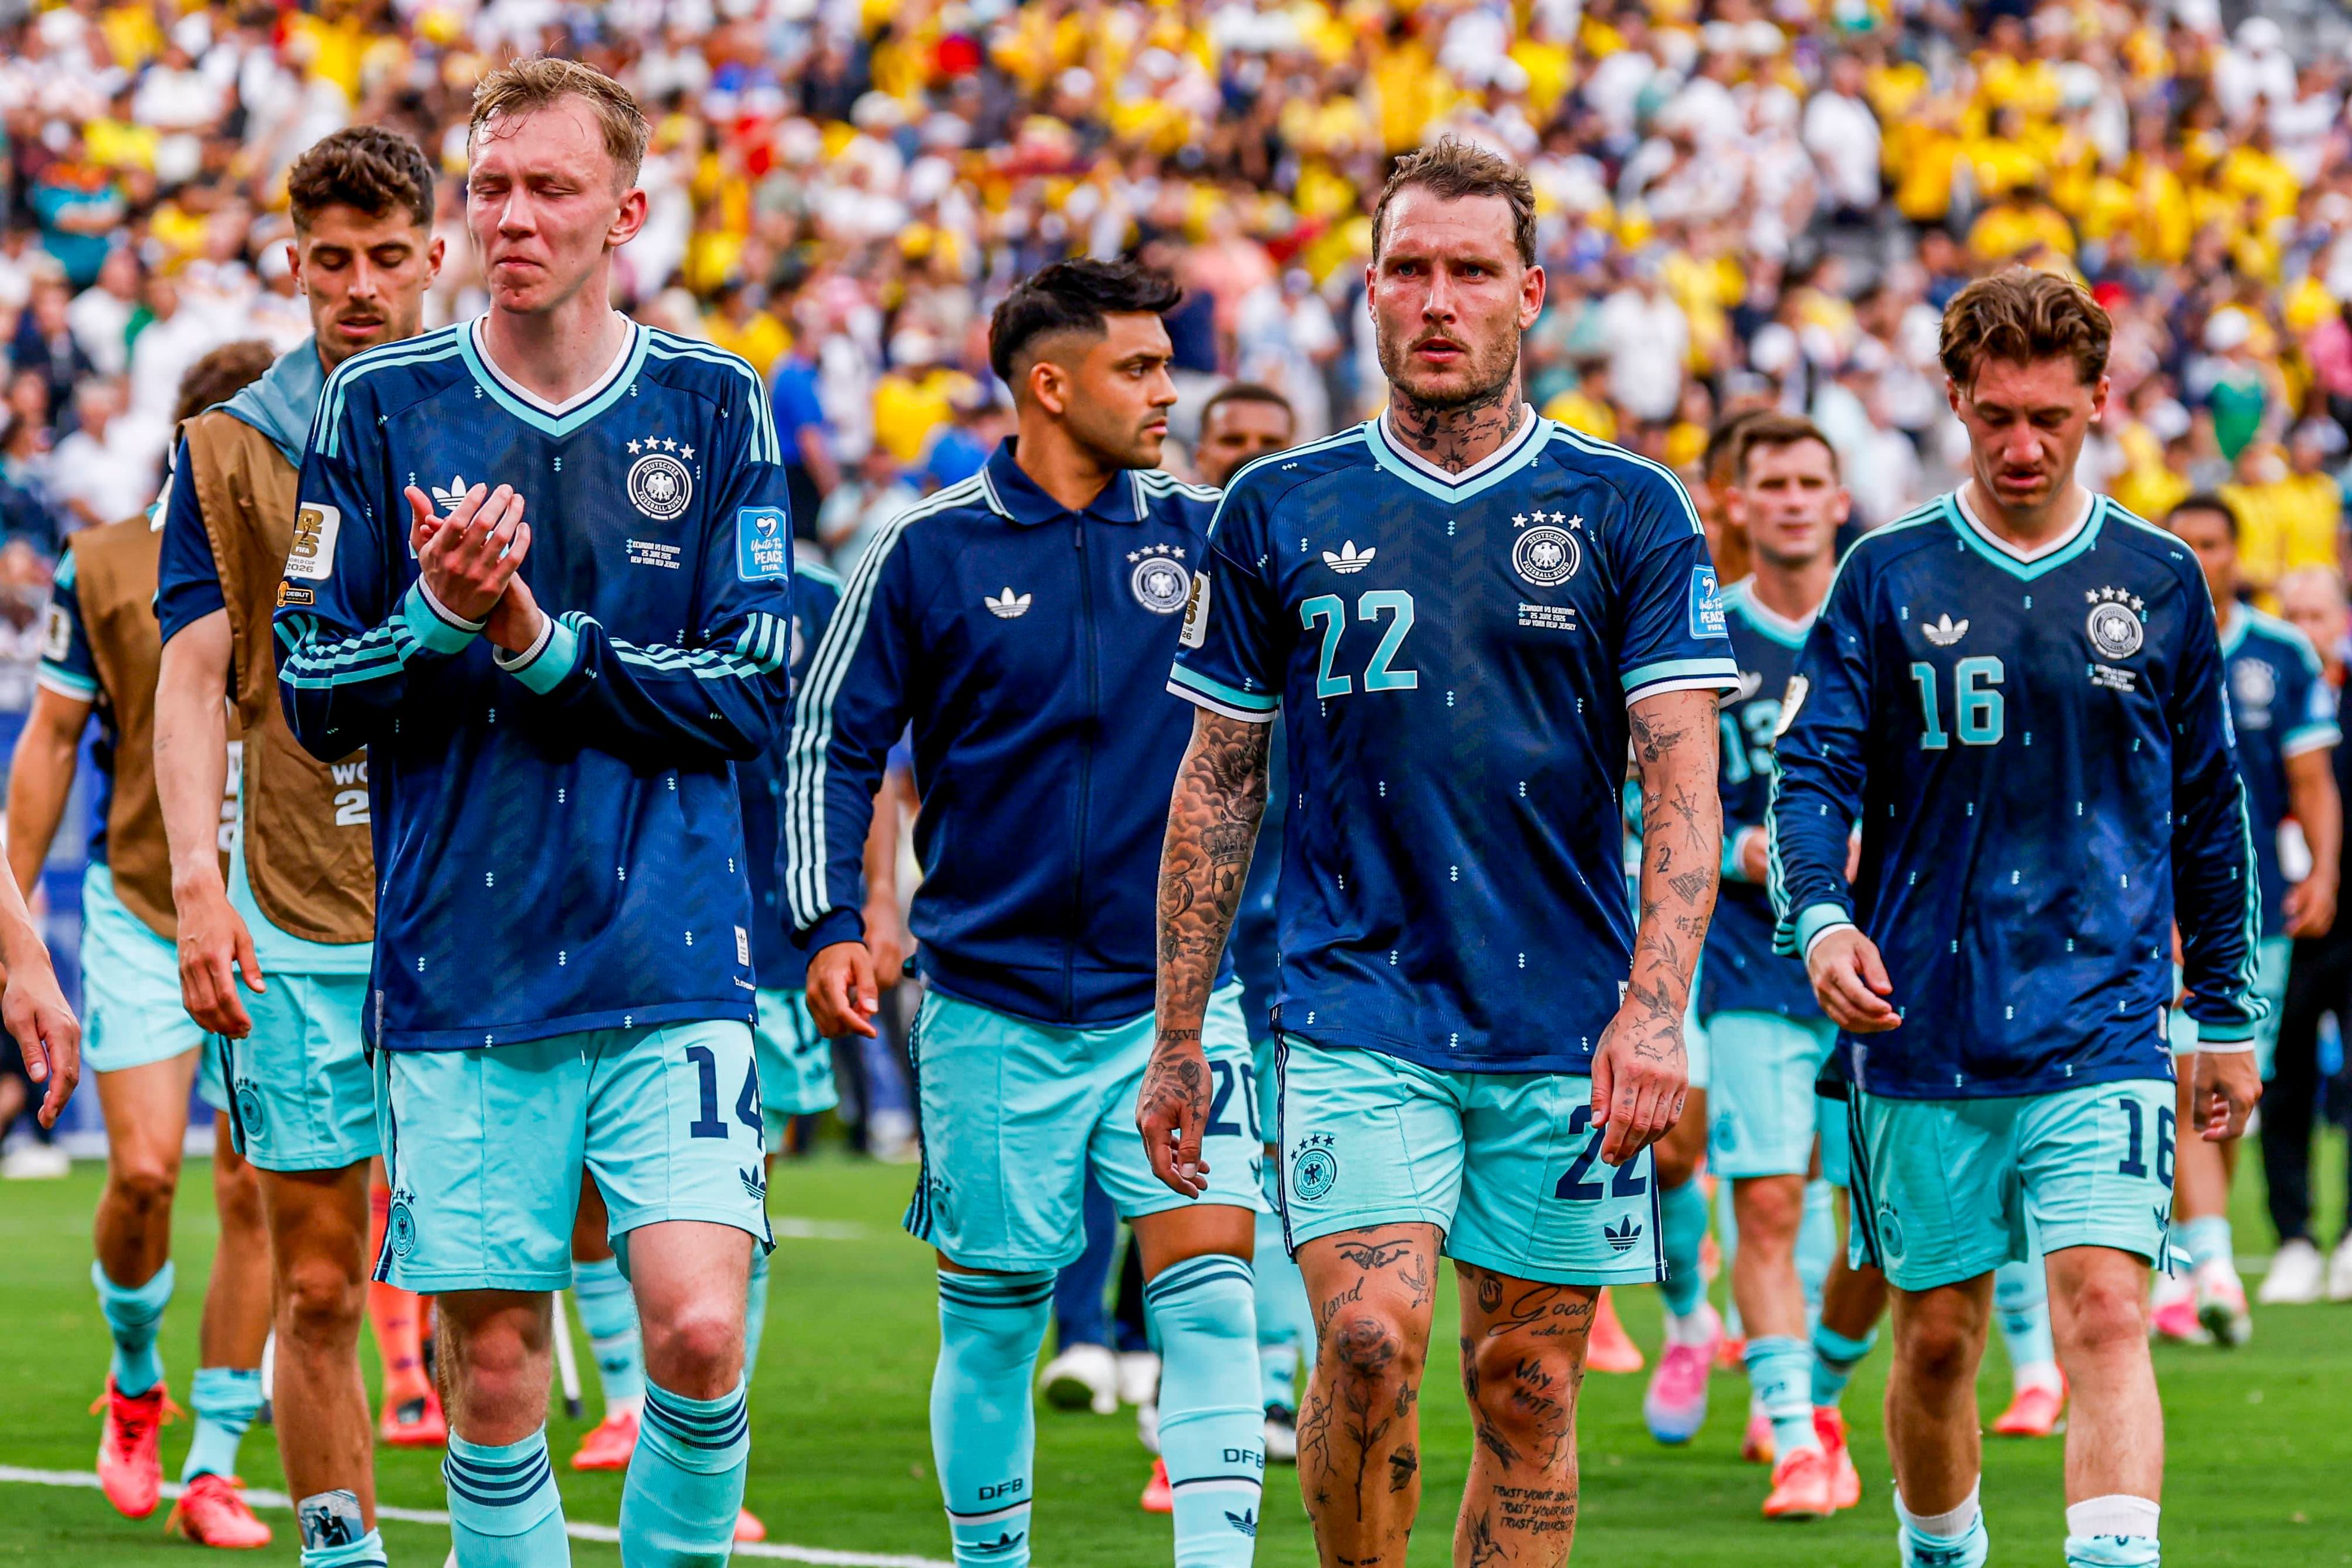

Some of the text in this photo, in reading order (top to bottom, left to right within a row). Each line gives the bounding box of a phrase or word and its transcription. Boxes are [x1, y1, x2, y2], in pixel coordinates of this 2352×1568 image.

[642, 462, 679, 476] DEUTSCHER
[1528, 533, 1566, 545] DEUTSCHER
[754, 550, 783, 565] PEACE
[1552, 607, 1575, 616] GERMANY
[1700, 611, 1726, 623] PEACE
[1558, 622, 1576, 631] JERSEY
[1182, 631, 1192, 640] 26
[1299, 590, 1418, 699] 22
[1910, 656, 2004, 750] 16
[686, 1046, 763, 1152] 14
[2119, 1098, 2176, 1191] 16
[1224, 1449, 1264, 1469] DFB
[978, 1478, 1023, 1500] DFB
[1493, 1485, 1523, 1498] TRUST
[1500, 1501, 1531, 1514] TRUST
[1501, 1517, 1534, 1529] TRUST
